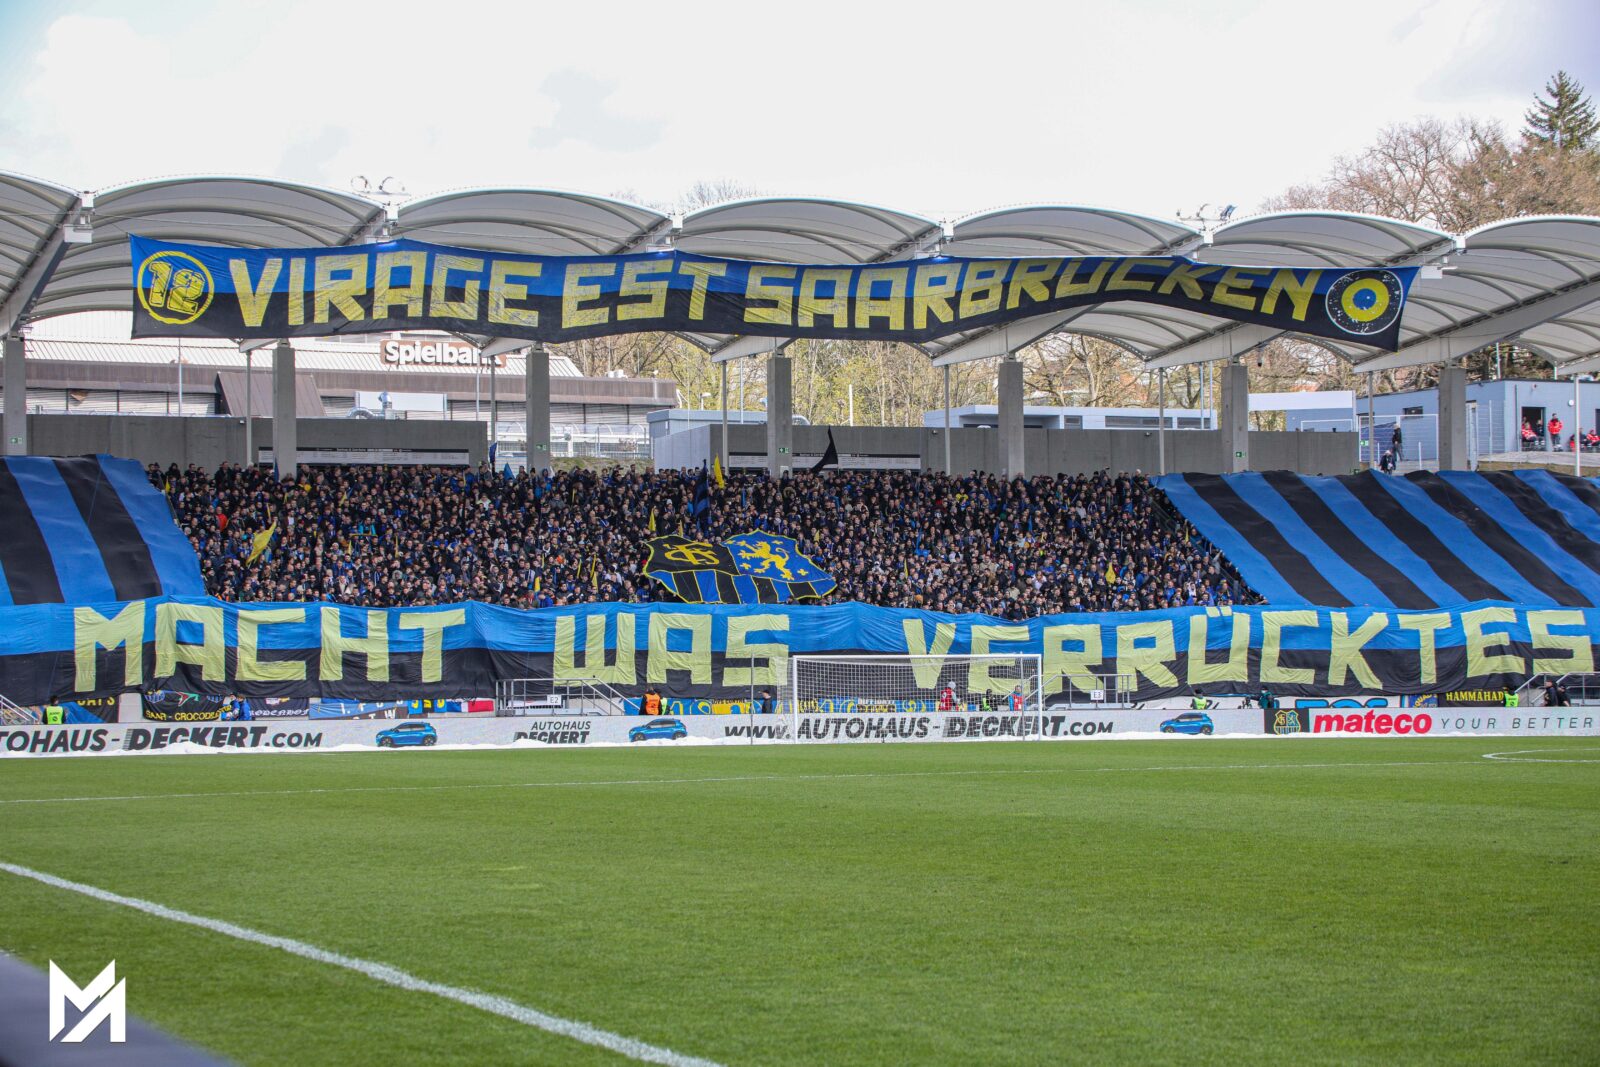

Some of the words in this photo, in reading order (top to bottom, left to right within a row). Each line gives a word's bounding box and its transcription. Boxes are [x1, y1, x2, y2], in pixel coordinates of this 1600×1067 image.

[229, 250, 543, 328] VIRAGE
[562, 258, 727, 329] EST
[74, 600, 466, 692] MACHT
[553, 612, 790, 687] WAS
[902, 606, 1594, 695] VERRÜCKTES
[531, 721, 592, 731] AUTOHAUS
[1313, 709, 1432, 734] mateco
[1441, 717, 1497, 729] YOUR
[1512, 717, 1594, 729] BETTER
